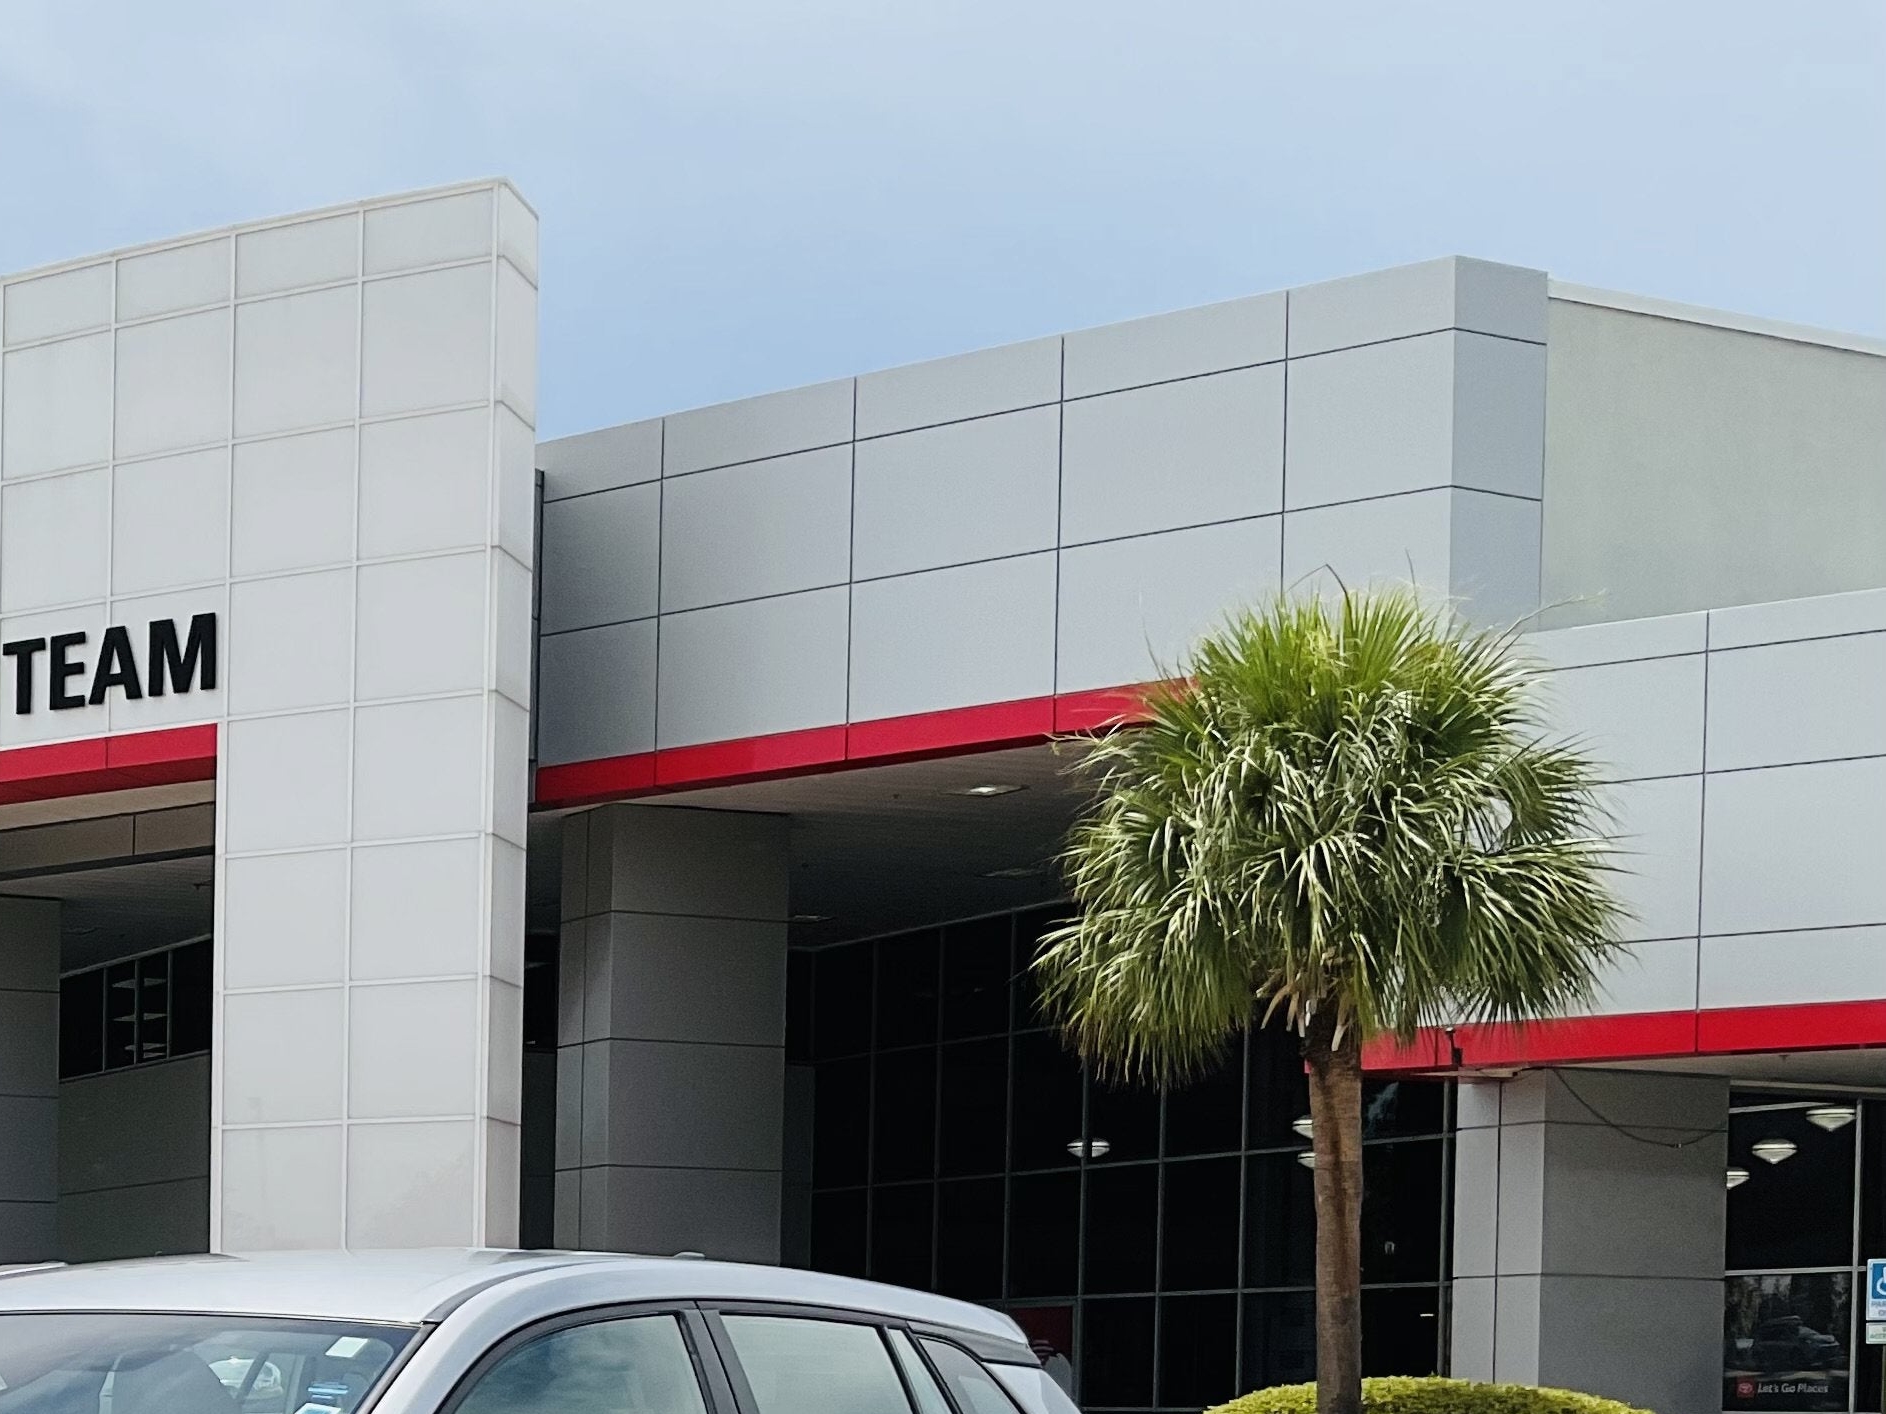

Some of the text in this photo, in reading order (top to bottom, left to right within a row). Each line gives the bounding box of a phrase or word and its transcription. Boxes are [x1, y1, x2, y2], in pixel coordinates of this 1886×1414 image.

[2, 612, 217, 715] TEAM
[1757, 1382, 1829, 1394] Let's Go Places
